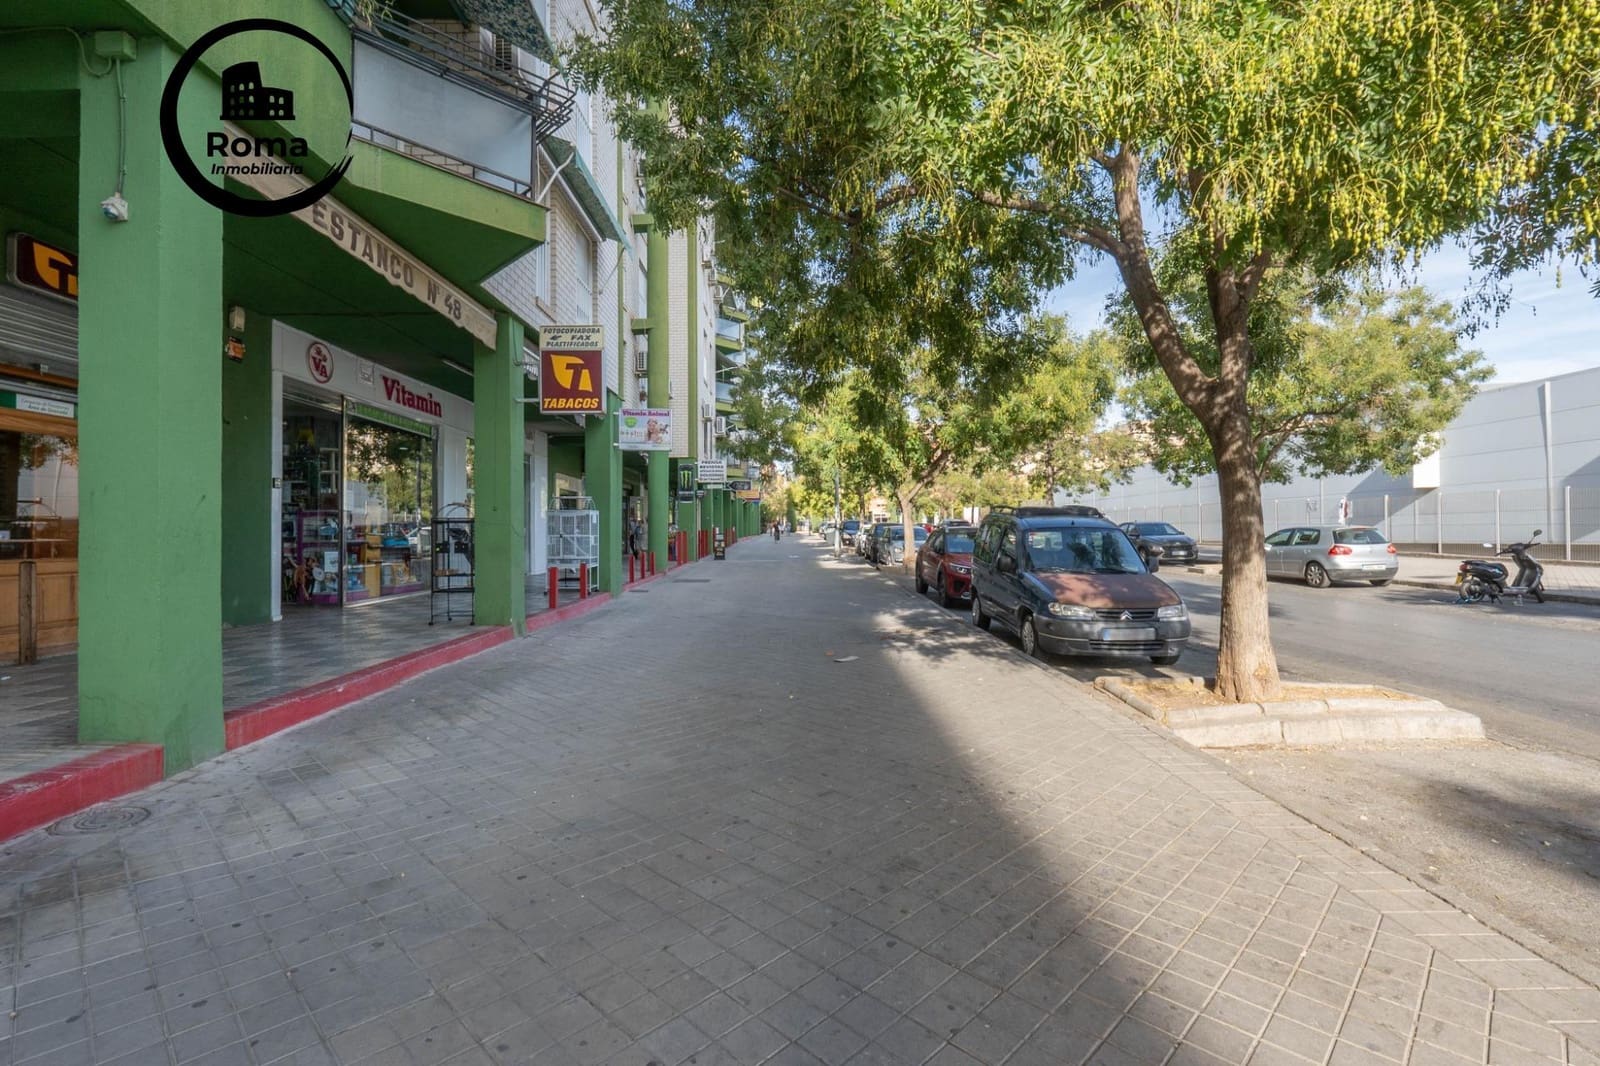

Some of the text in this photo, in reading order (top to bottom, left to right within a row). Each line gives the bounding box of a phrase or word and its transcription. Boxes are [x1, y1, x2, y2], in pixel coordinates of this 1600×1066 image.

[313, 202, 414, 289] ESTANCO
[444, 294, 462, 321] 48
[382, 374, 442, 418] Vitamin
[543, 398, 600, 409] TABACOS
[622, 409, 647, 417] Vitamin
